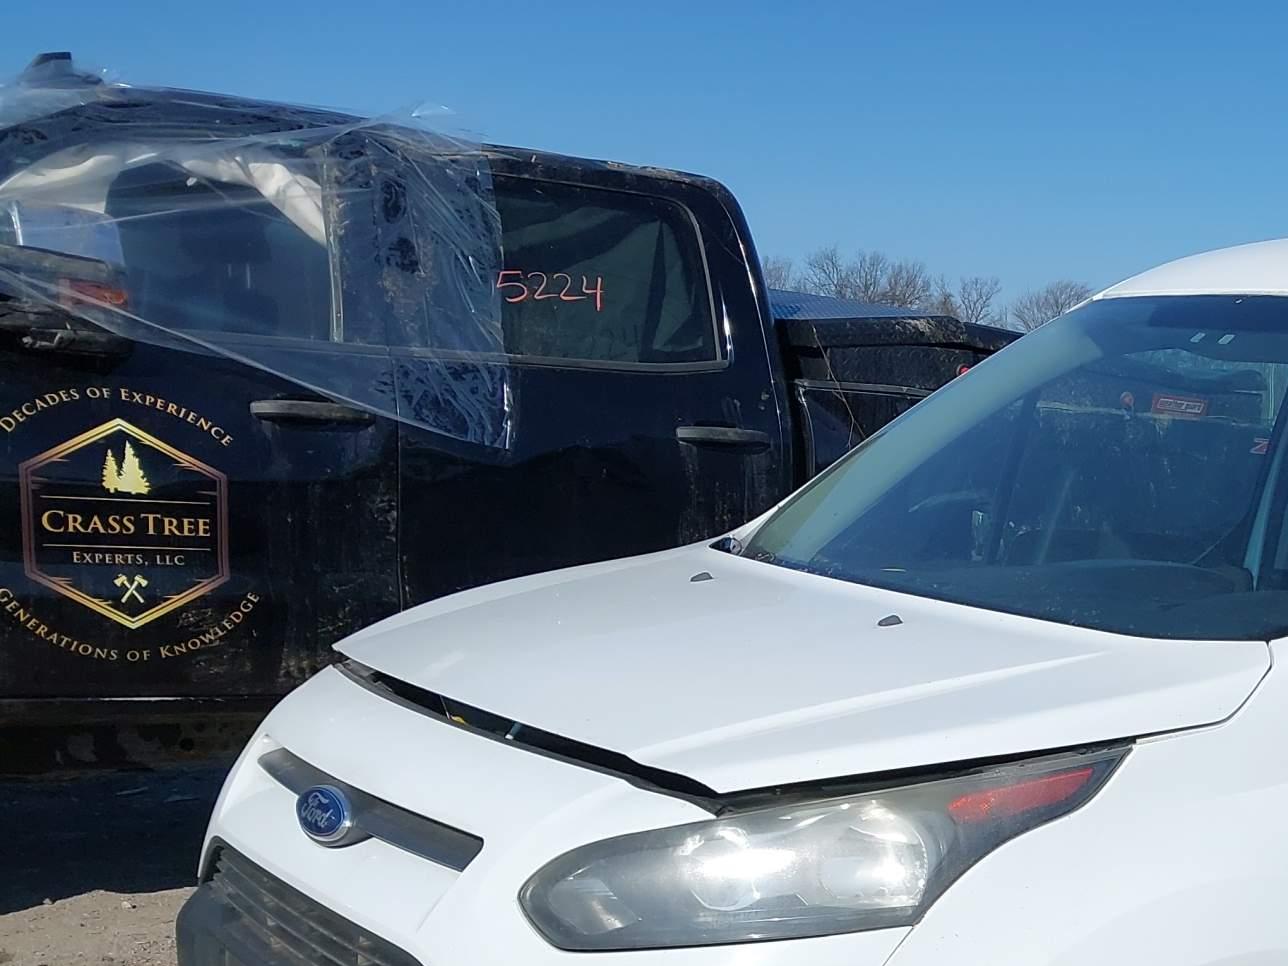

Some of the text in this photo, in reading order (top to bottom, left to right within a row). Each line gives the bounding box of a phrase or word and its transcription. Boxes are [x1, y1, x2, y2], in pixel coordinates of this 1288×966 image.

[496, 270, 604, 312] 5224
[0, 387, 233, 447] DECADES OF EXPERIENCE
[41, 510, 211, 537] CRASS TREE
[72, 551, 185, 567] EXPERTS, LLC
[0, 588, 260, 661] GENERATIONS OF KNOWLEDGE
[301, 792, 334, 828] Ford
